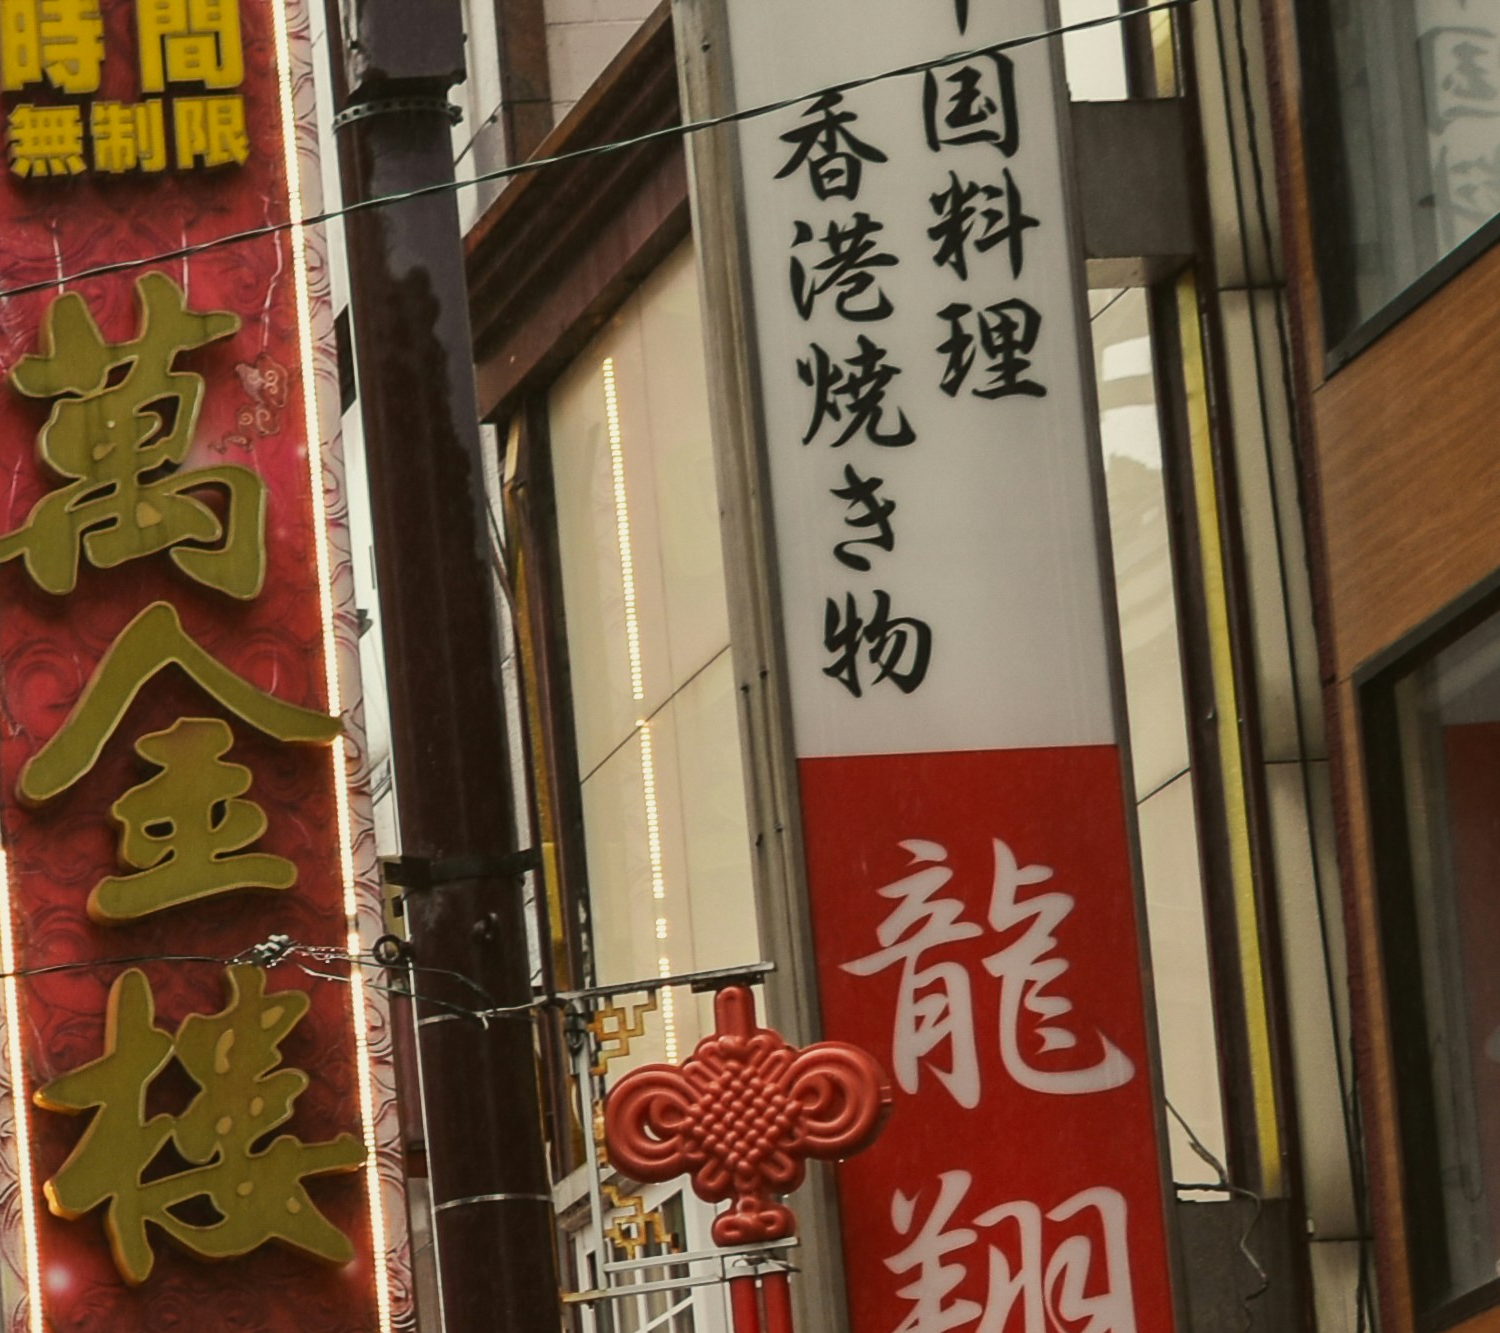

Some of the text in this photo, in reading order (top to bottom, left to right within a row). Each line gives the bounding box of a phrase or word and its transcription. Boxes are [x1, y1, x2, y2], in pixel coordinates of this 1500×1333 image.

[7, 95, 248, 177] 無制限
[920, 0, 1048, 400] 国料理
[774, 93, 933, 698] 香港焼き物
